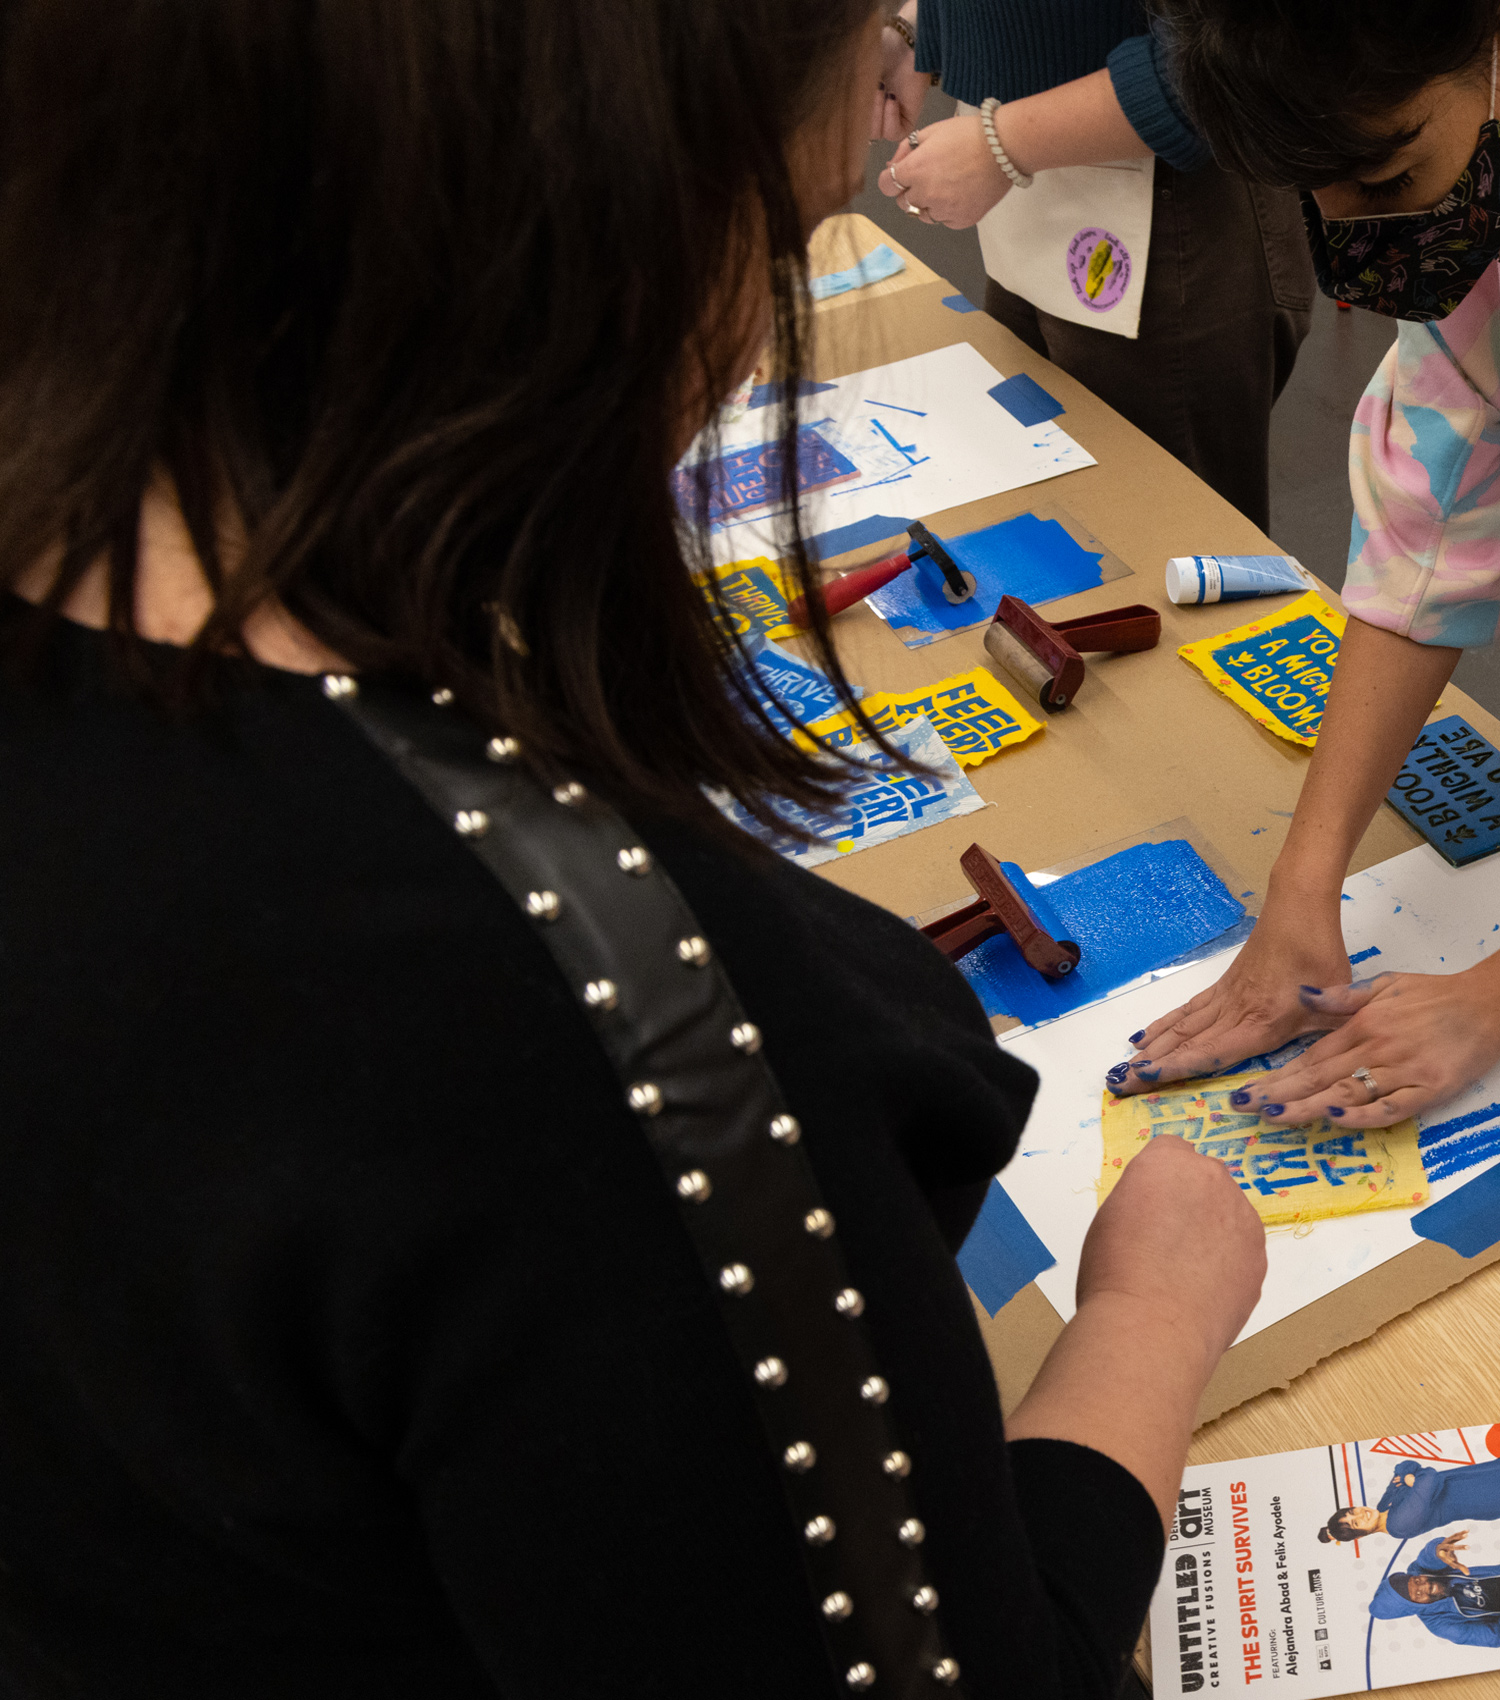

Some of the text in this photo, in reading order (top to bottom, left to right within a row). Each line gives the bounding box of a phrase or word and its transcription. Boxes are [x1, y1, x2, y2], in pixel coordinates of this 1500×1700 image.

[722, 573, 788, 627] THRIVE
[1259, 638, 1290, 657] A
[755, 661, 836, 704] THRIVE
[1241, 664, 1325, 728] BLOOM
[1276, 654, 1332, 702] MIGH
[936, 682, 1022, 750] FEEL
[1202, 1486, 1215, 1536] MUSEUM
[1230, 1481, 1263, 1685] THE SPIRIT SURVIVES
[1269, 1495, 1299, 1676] Alejandra Abad & Felix Ayodele
[1174, 1553, 1206, 1694] UNTITLED
[1202, 1550, 1220, 1688] CREATIVE FUSIONS
[1269, 1628, 1280, 1679] FEATURING:
